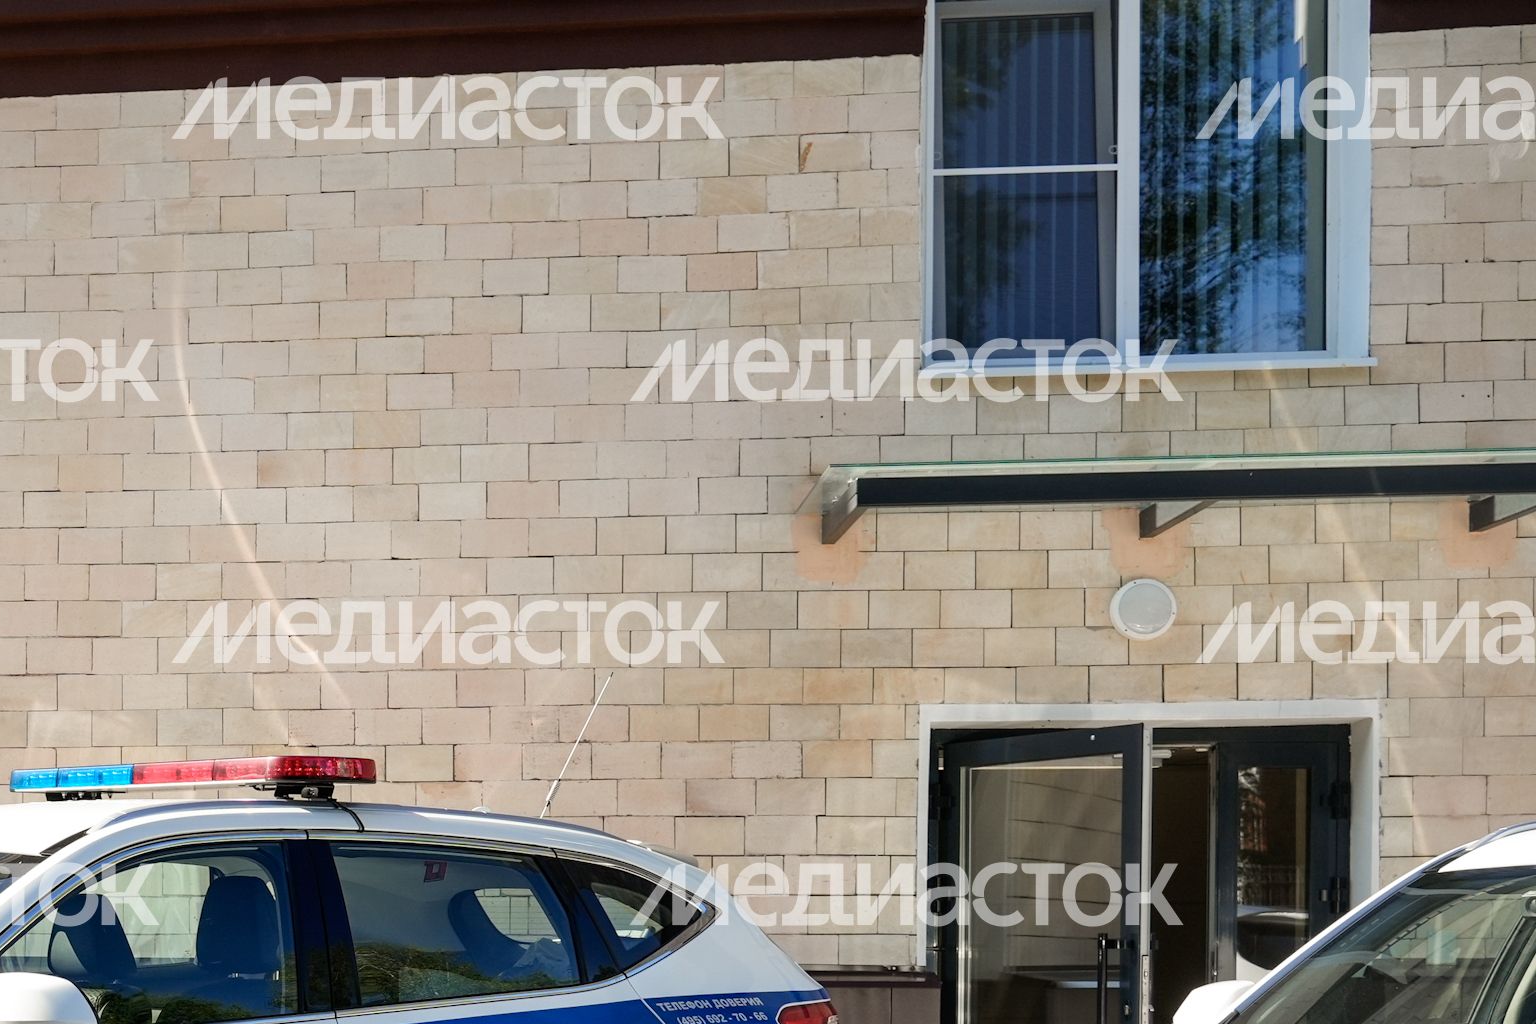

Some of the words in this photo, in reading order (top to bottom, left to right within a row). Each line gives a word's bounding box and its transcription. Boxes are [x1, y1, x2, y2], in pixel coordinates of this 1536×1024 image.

[656, 999, 712, 1012] ТЕЛЕФОН
[712, 997, 764, 1010] ДОВЕРИЯ
[706, 1013, 728, 1024] 692
[732, 1012, 747, 1022] 70
[753, 1011, 768, 1021] 66
